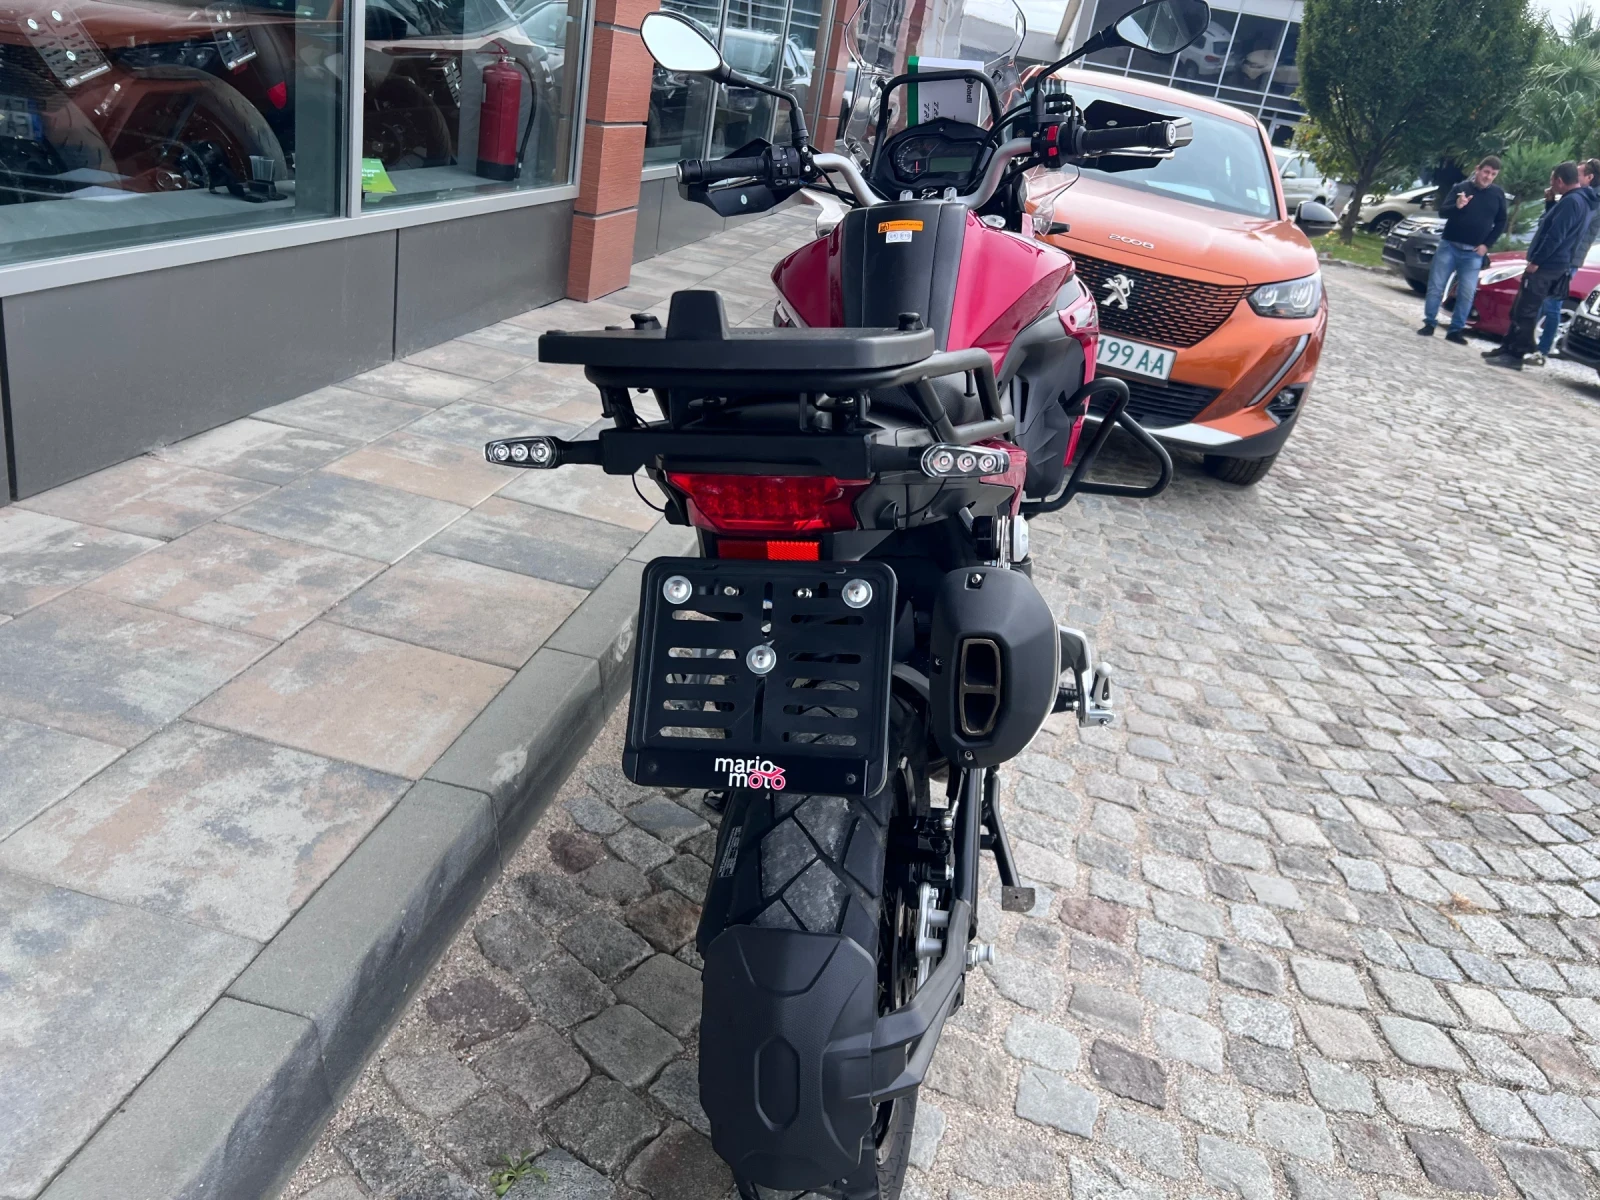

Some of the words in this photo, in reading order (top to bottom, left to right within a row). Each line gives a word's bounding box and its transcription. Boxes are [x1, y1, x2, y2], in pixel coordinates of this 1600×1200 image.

[1109, 233, 1154, 249] 2008
[1097, 338, 1134, 366] 199
[1135, 349, 1165, 375] AA
[714, 755, 774, 774] mario
[728, 771, 786, 791] moto
